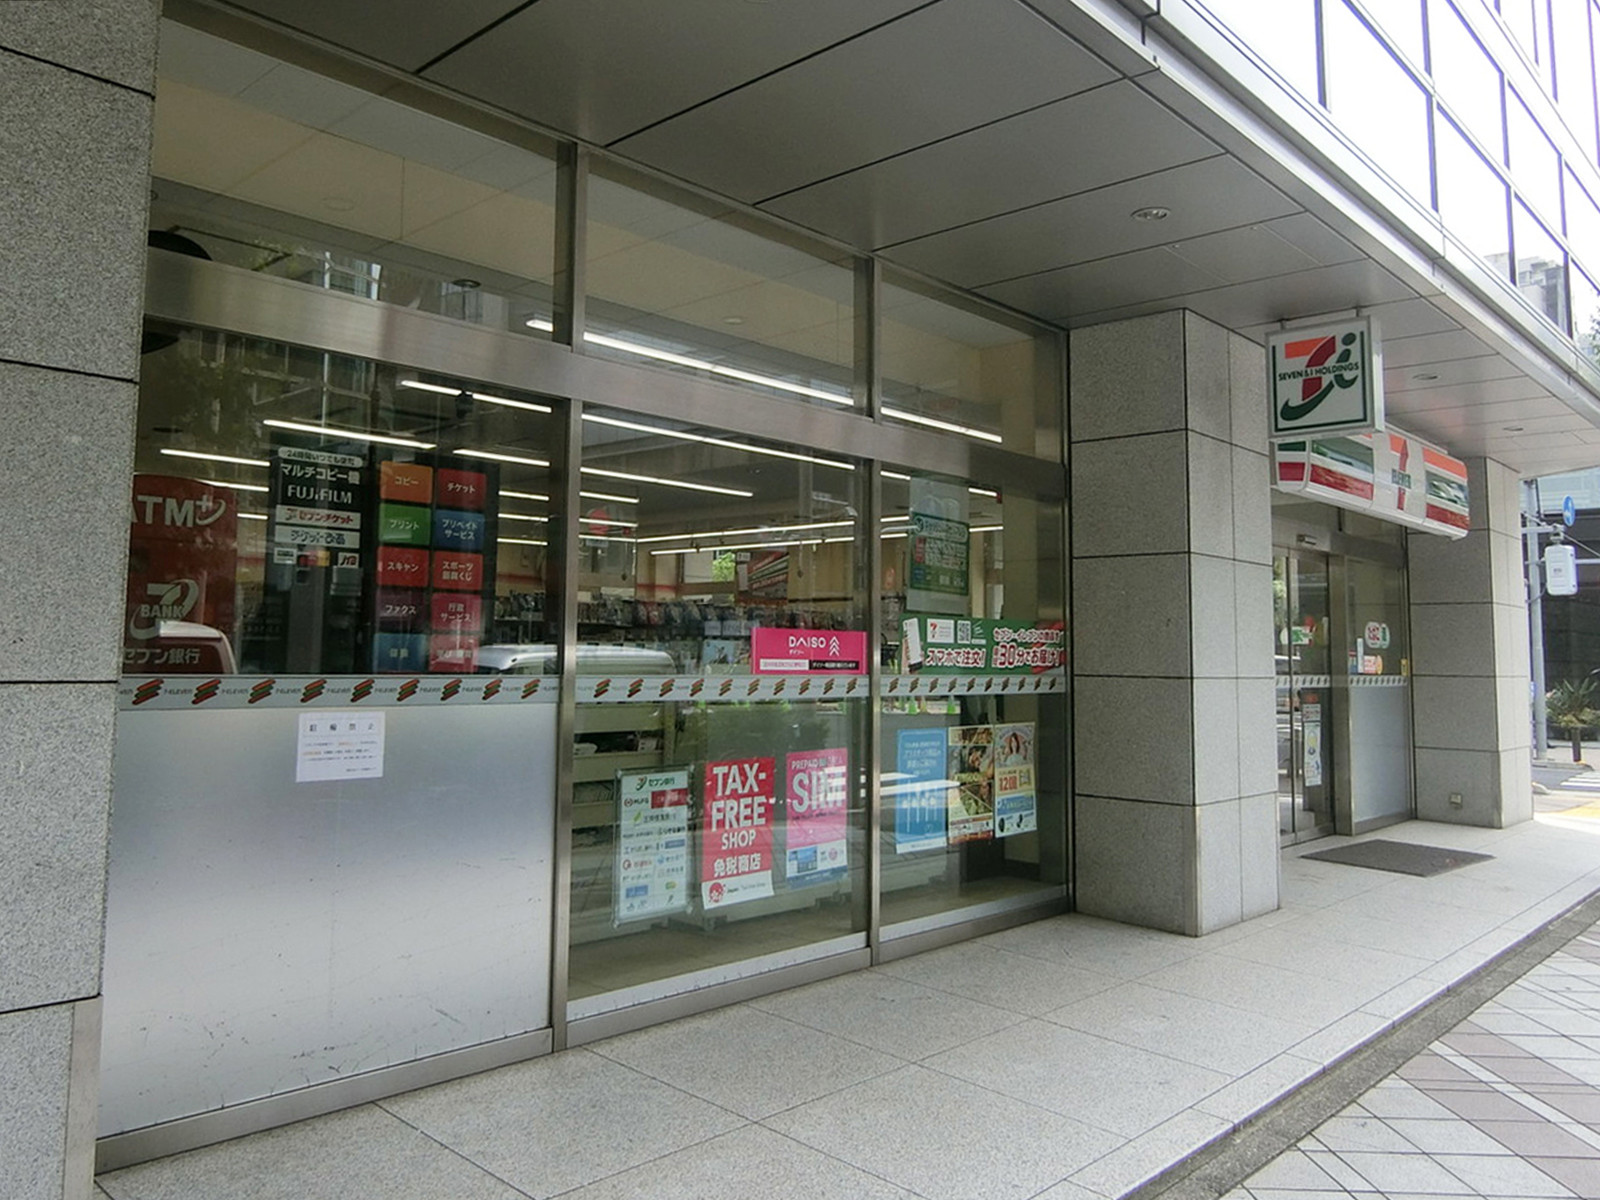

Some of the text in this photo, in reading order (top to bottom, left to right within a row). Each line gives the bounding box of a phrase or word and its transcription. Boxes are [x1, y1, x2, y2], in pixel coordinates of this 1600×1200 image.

[1315, 361, 1359, 376] HOLDINGS
[280, 463, 360, 485] マルチコピー機
[394, 476, 419, 486] コピー
[447, 483, 475, 493] チケット
[389, 519, 420, 530] プリント
[444, 529, 475, 540] サービス
[387, 562, 419, 572] スキャン
[443, 561, 474, 571] スポーツ
[140, 603, 184, 619] BANK
[385, 604, 417, 615] ファクス
[440, 613, 472, 622] サービス
[788, 635, 827, 648] DAISO
[713, 762, 766, 796] TAX-
[711, 795, 767, 832] FREE
[721, 829, 756, 850] SHOP
